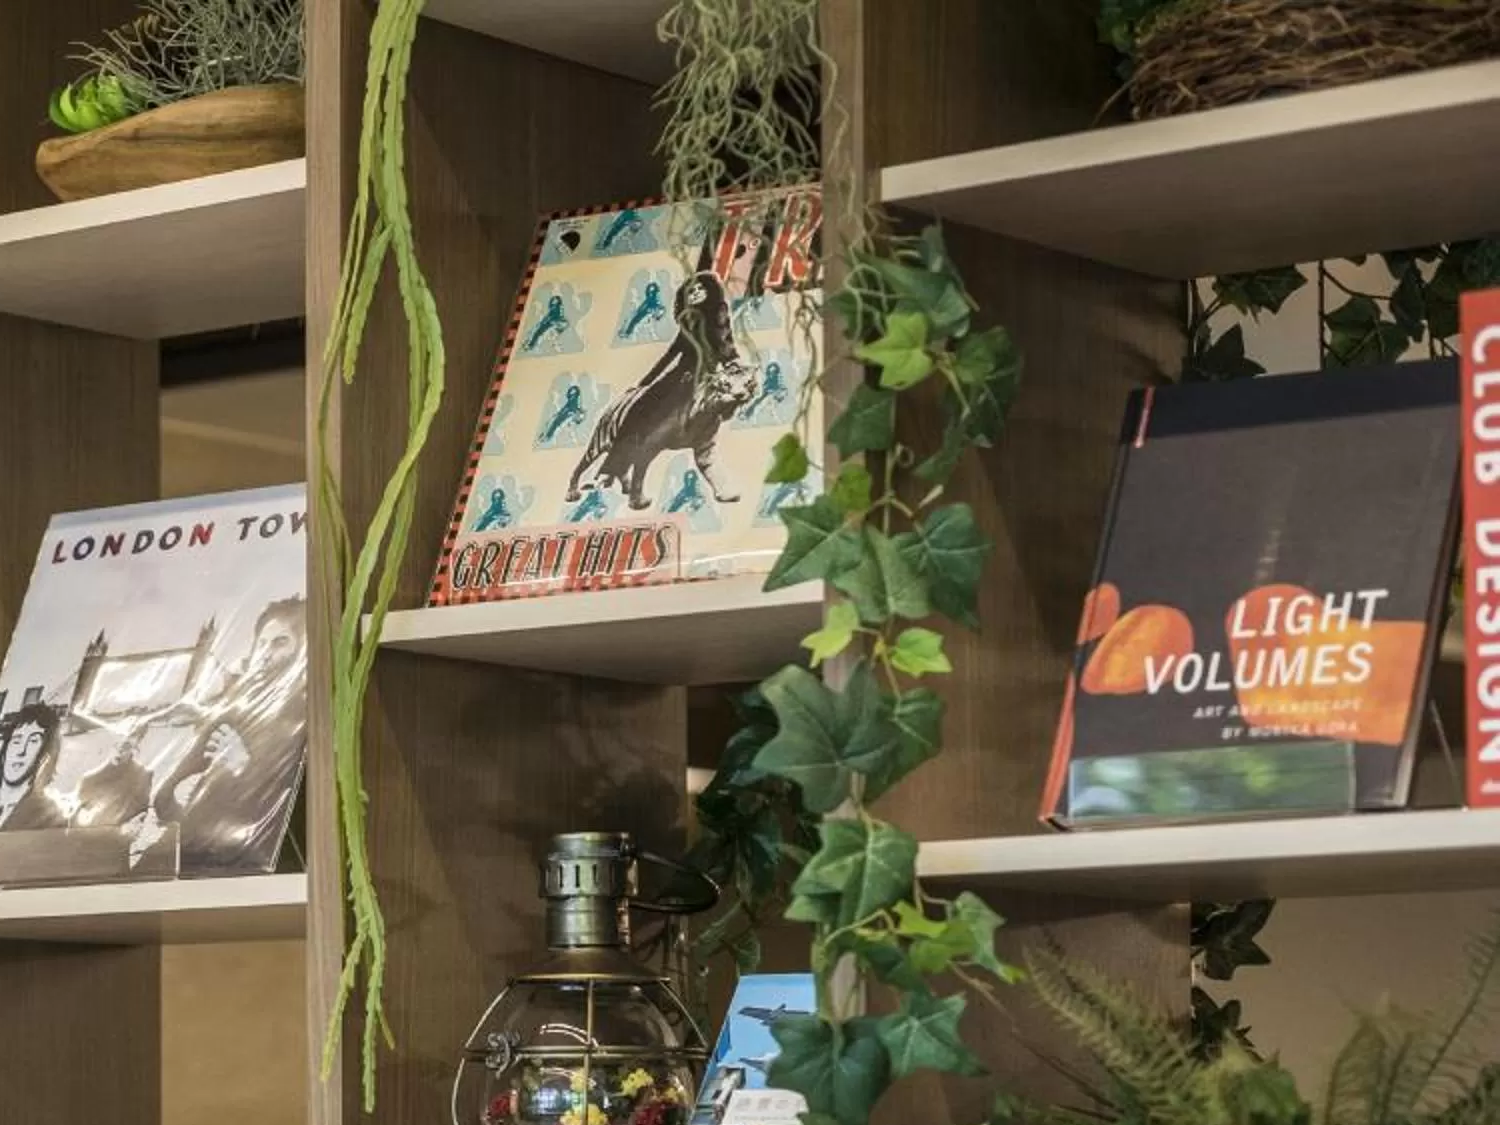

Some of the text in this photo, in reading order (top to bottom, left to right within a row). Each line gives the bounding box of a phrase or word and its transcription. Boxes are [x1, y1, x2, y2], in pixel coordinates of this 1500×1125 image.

[52, 522, 214, 564] LONDON
[453, 521, 674, 590] GREAT HITS
[1232, 589, 1389, 638] LIGHT
[1144, 641, 1374, 695] VOLUMES
